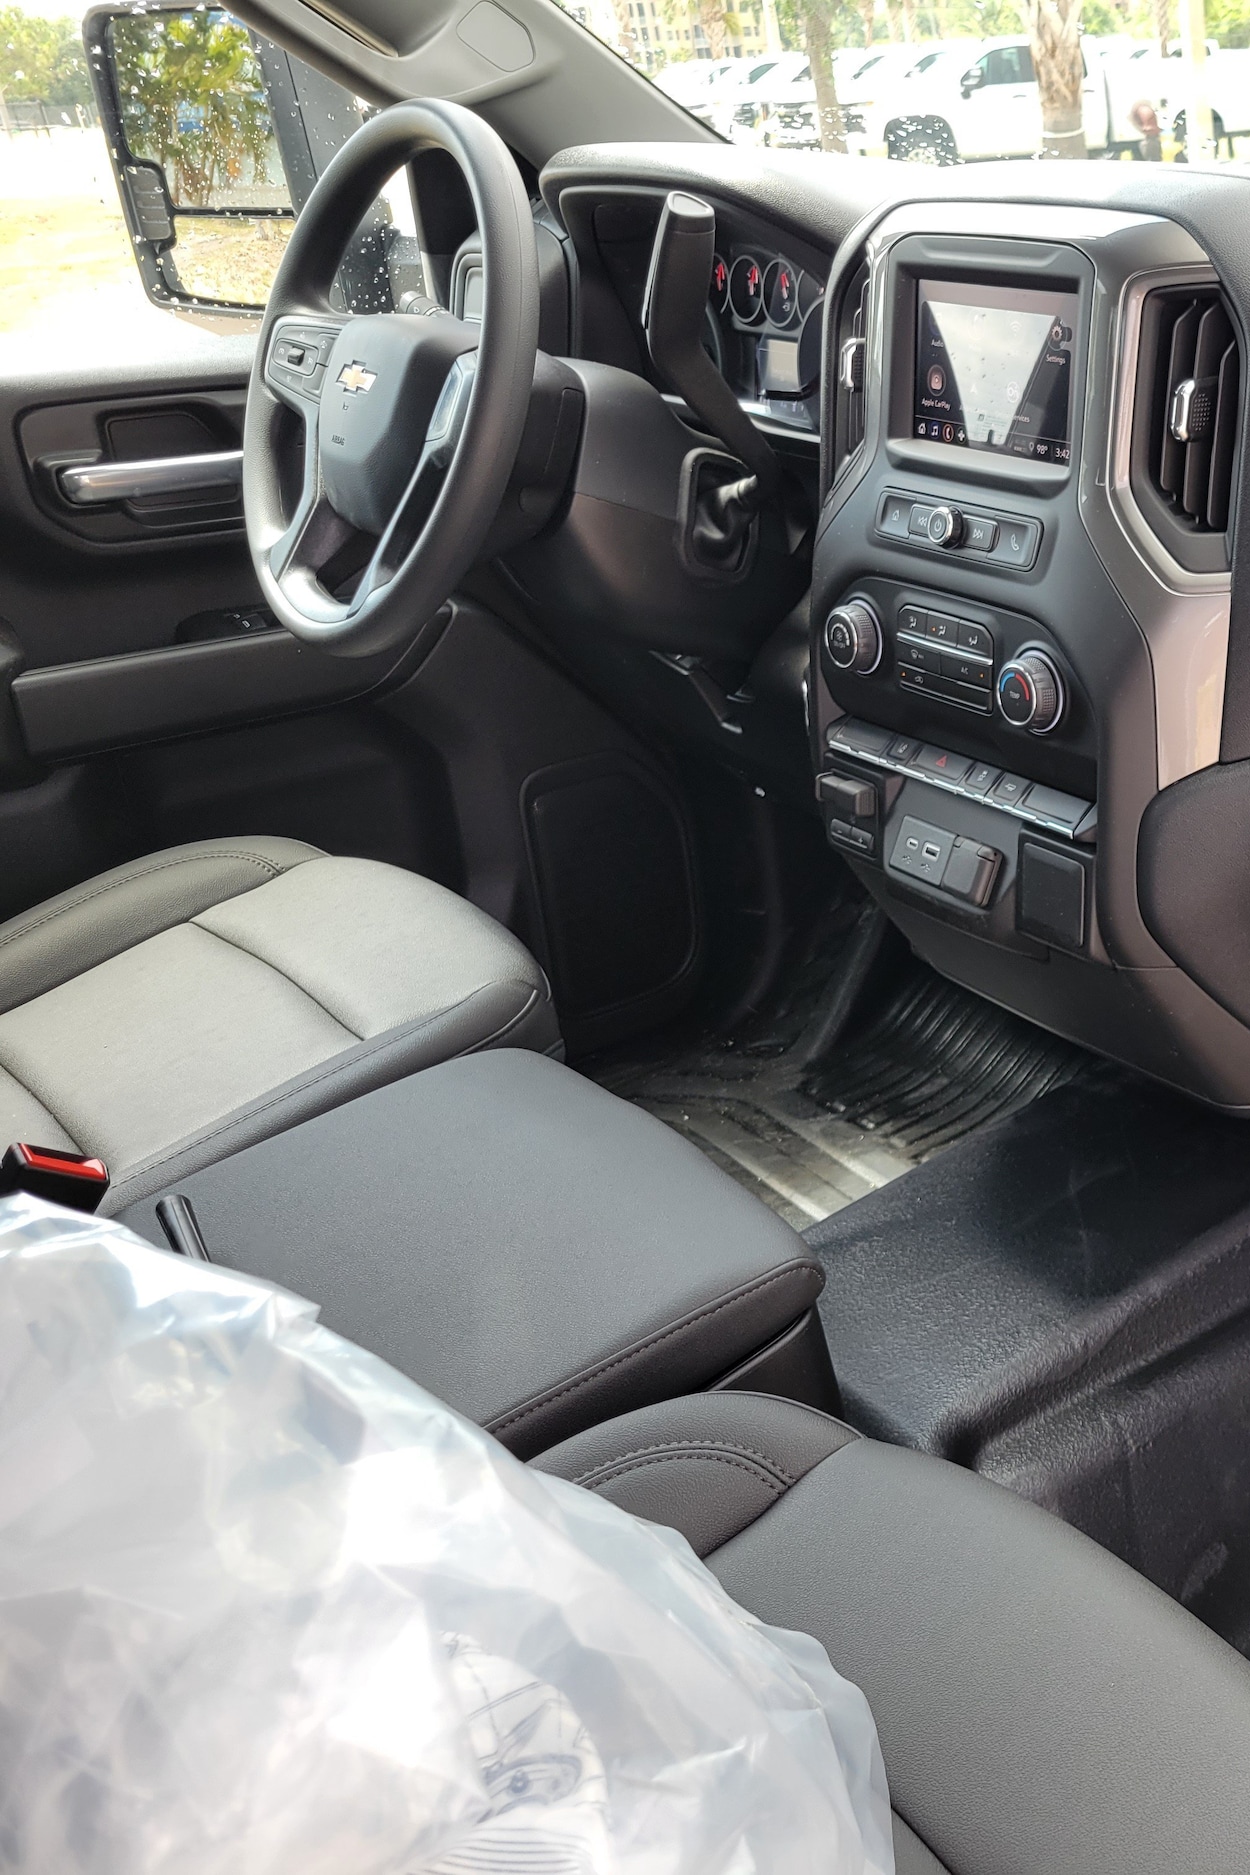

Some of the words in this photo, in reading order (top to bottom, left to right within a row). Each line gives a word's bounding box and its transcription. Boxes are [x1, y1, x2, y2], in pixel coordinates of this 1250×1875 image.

[931, 339, 944, 348] Audio
[1046, 354, 1066, 365] Settings
[922, 398, 934, 407] Apple
[935, 400, 951, 411] CarPlay
[1055, 448, 1070, 459] 3:42
